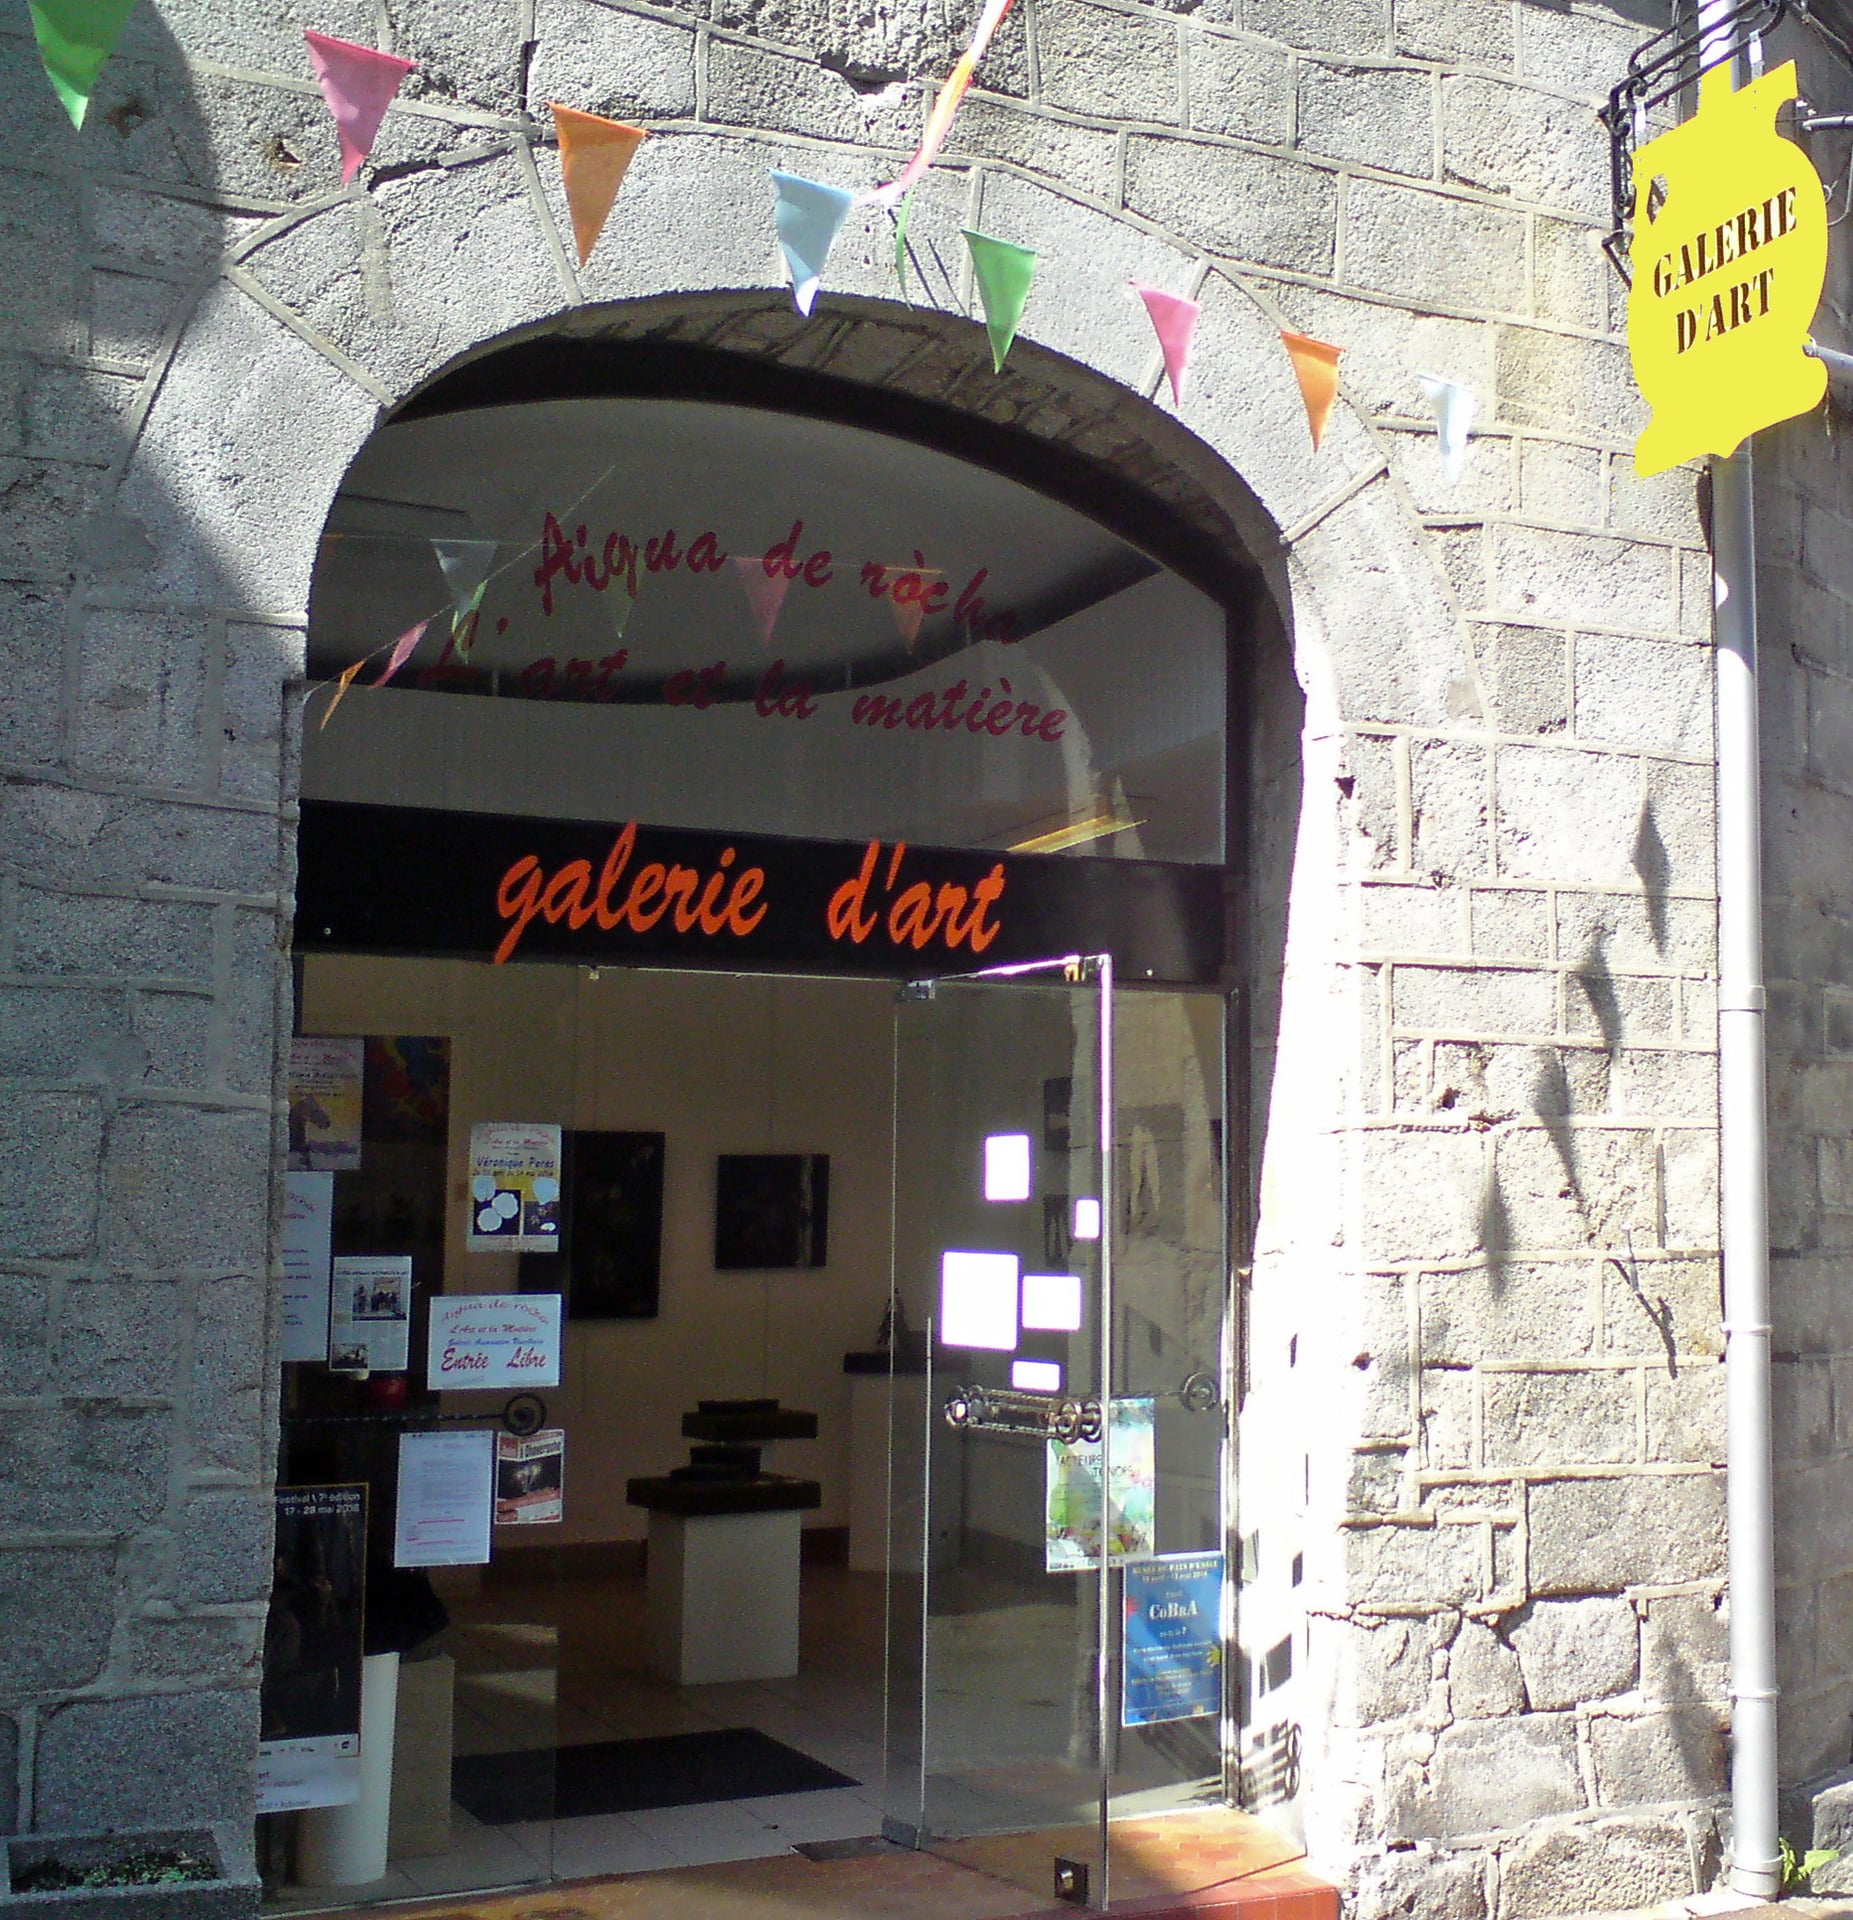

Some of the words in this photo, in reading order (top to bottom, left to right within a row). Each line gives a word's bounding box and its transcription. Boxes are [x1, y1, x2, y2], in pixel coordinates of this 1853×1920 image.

[1653, 185, 1797, 298] GALERIE
[1676, 267, 1774, 355] D'ART
[762, 520, 833, 587] de
[662, 660, 727, 710] et
[755, 658, 819, 720] la
[851, 676, 1068, 743] matière
[493, 819, 768, 965] galerie
[827, 837, 1006, 953] d'art
[440, 1347, 489, 1373] Entrée
[506, 1346, 548, 1369] Libre
